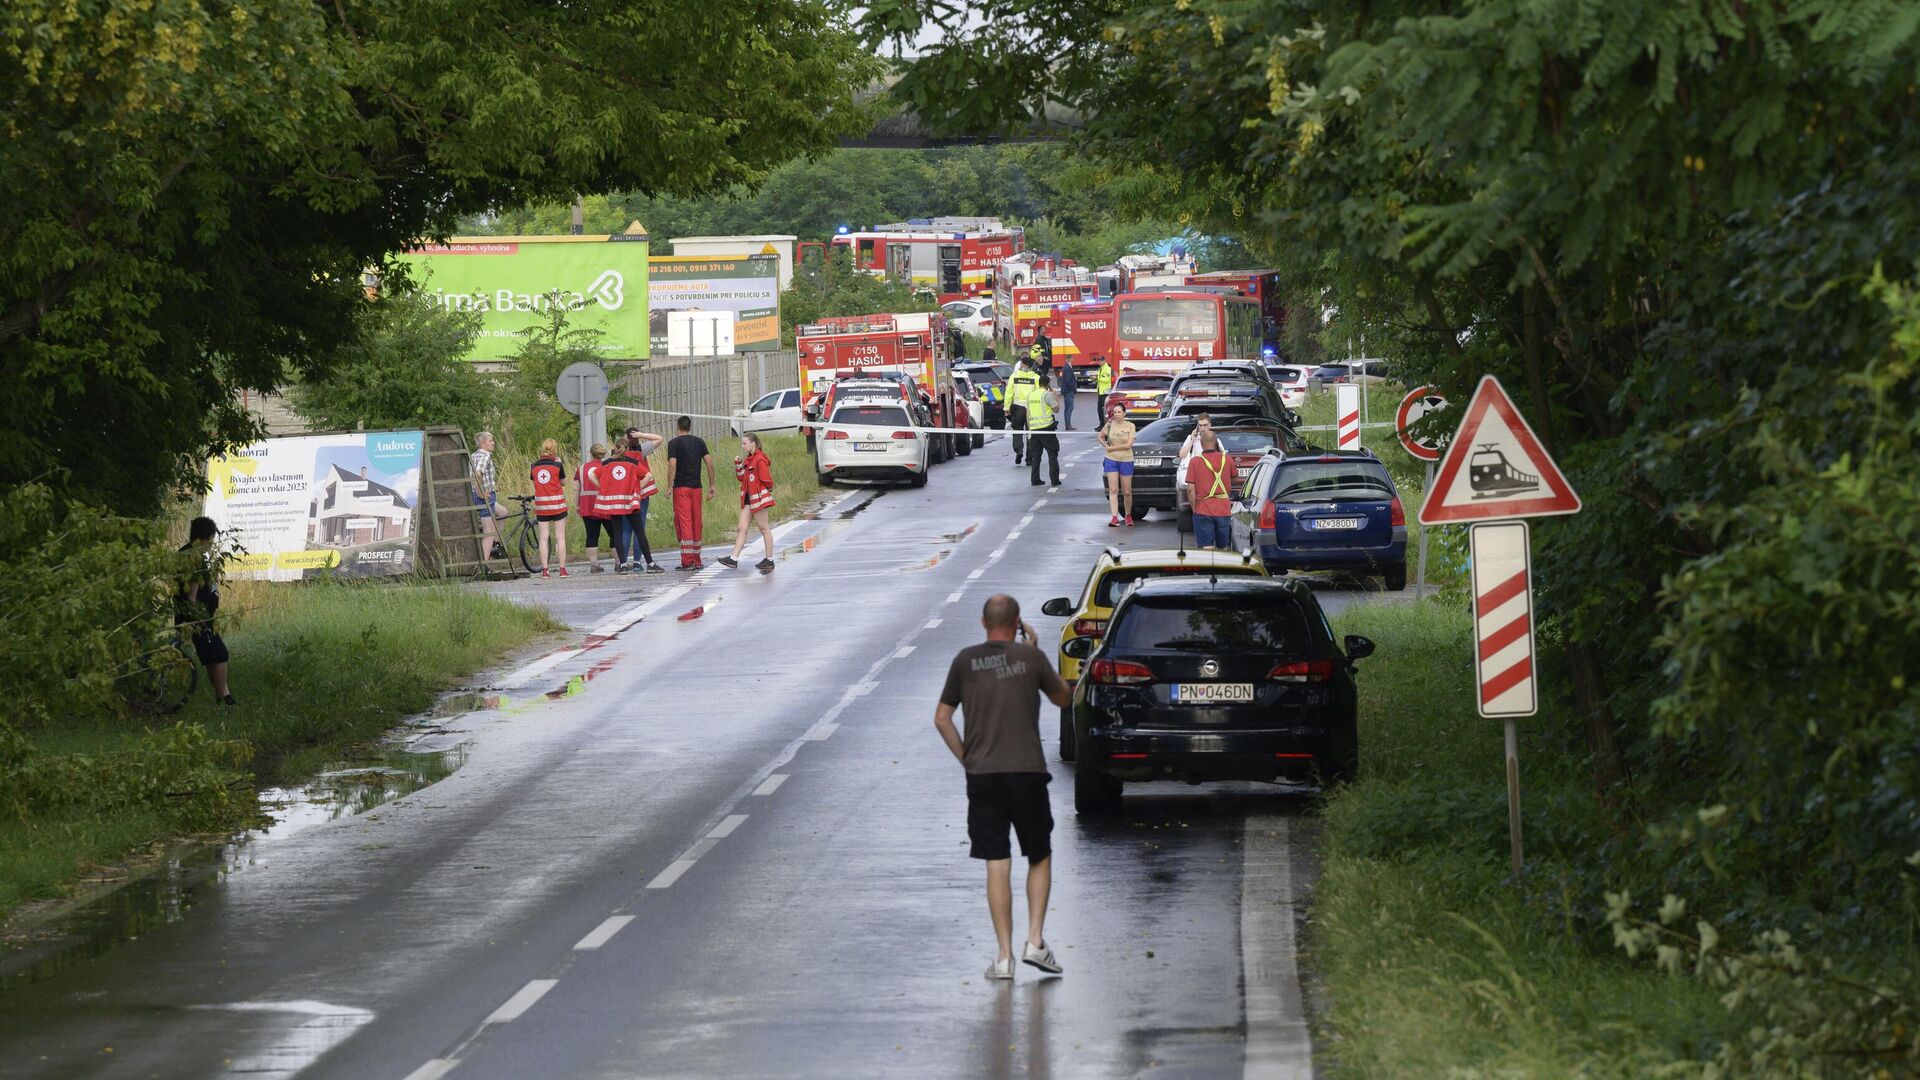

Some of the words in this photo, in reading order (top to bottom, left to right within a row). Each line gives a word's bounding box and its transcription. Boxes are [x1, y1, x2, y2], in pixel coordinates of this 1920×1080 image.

[480, 243, 510, 252] výhodne
[496, 288, 585, 312] Banka
[676, 292, 718, 300] POTVRDENÍM
[1040, 293, 1071, 302] HASIČI
[1080, 320, 1106, 330] HASIČI
[861, 346, 878, 354] 150
[1144, 345, 1193, 356] HASIČI
[848, 354, 884, 366] HASIČI
[228, 486, 250, 494] dome
[251, 484, 260, 493] už
[268, 484, 285, 492] roku
[286, 482, 307, 491] 2023!
[1316, 520, 1327, 528] NZ
[358, 551, 393, 559] PROSPECT
[971, 654, 1007, 672] RADOST
[1179, 685, 1198, 699] PN
[1206, 685, 1251, 699] 046DN
